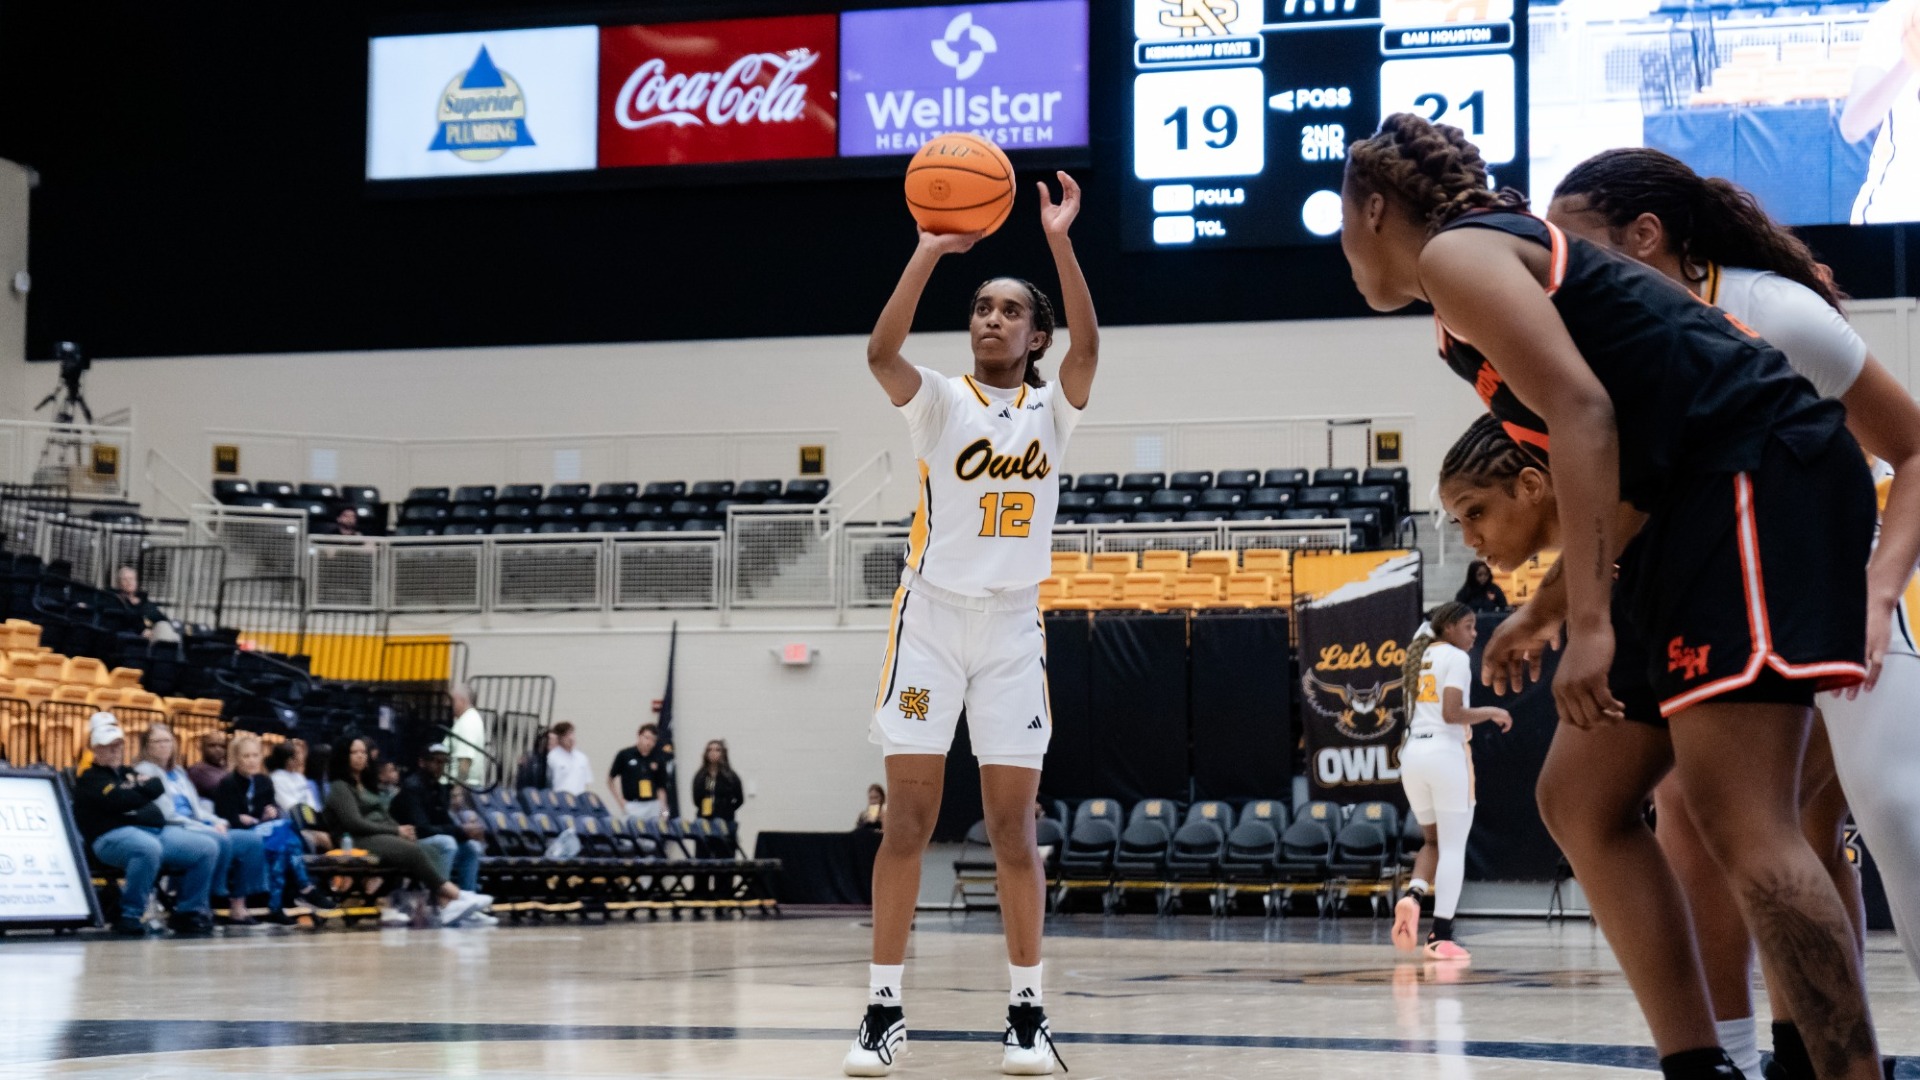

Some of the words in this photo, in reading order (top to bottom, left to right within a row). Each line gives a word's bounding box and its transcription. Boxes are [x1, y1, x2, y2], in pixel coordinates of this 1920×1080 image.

[1430, 27, 1491, 44] HOUSTON
[1145, 43, 1213, 60] KENNESAW
[1213, 41, 1251, 56] STATE
[614, 48, 820, 130] Coca-Cola
[1296, 87, 1351, 109] POSS
[446, 89, 519, 118] Superior
[865, 86, 1062, 130] Wellstar
[446, 120, 517, 144] PLUMBING
[1163, 104, 1239, 150] 19
[1301, 124, 1344, 142] 2ND
[1301, 141, 1345, 160] QTR
[1195, 188, 1244, 205] FOULS
[1195, 220, 1226, 236] TOL
[955, 437, 1051, 481] Owls
[978, 491, 1036, 538] 12
[1315, 642, 1373, 671] Let's
[1375, 639, 1406, 667] Go
